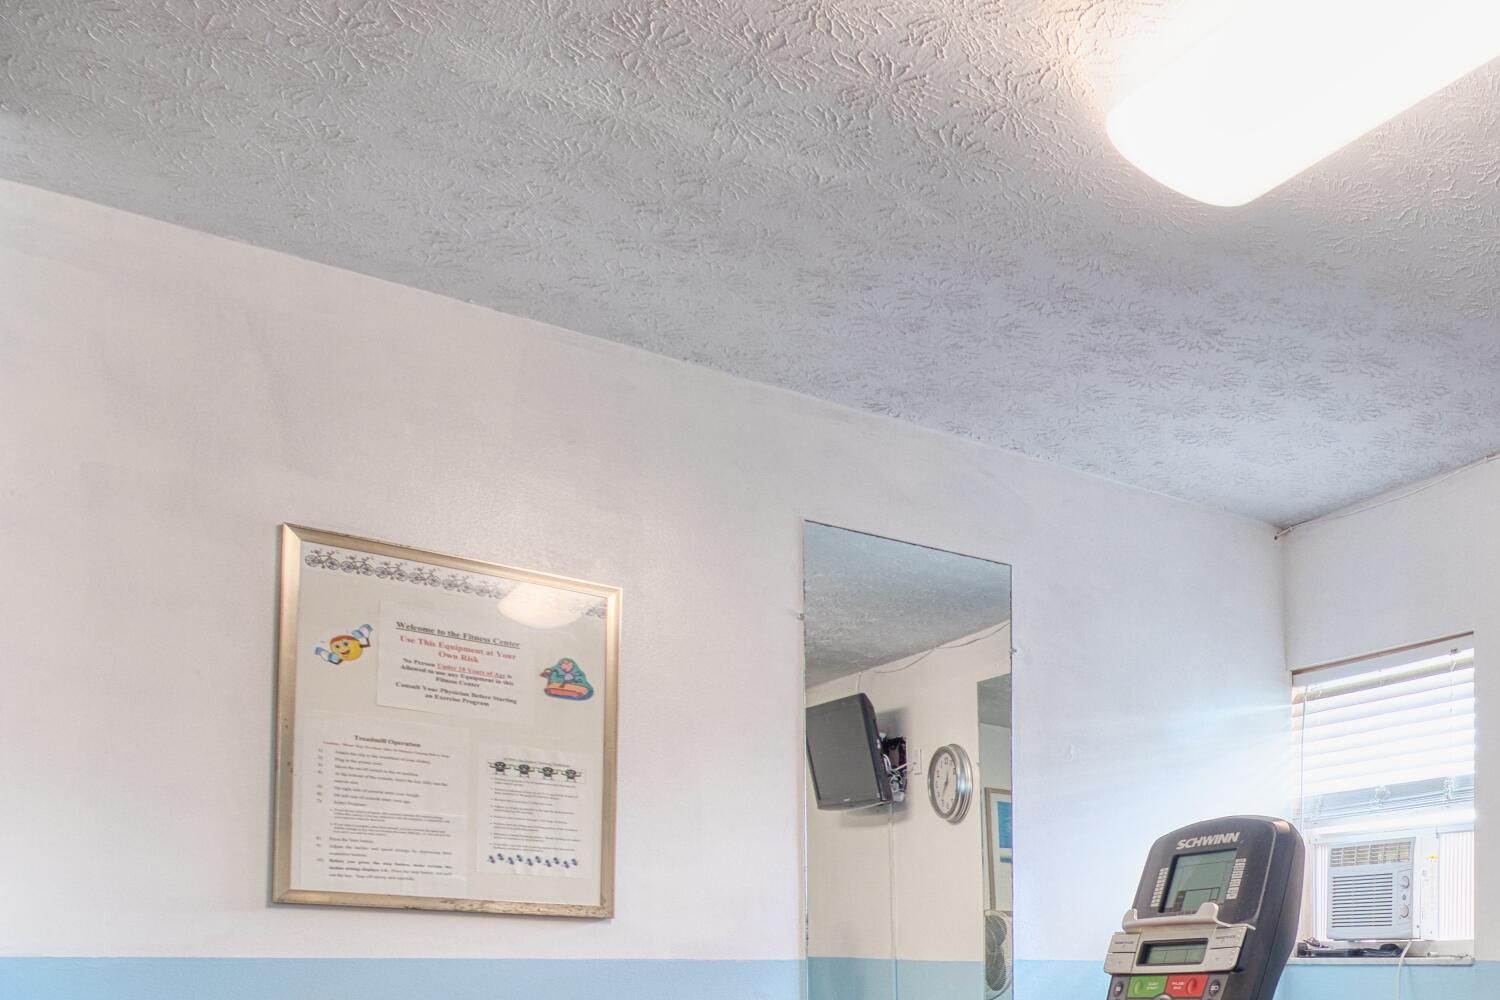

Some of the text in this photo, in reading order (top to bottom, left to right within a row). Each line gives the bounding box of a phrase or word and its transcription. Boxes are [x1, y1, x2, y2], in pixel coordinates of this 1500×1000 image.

[396, 621, 520, 648] Welcome to the Fitness Center
[400, 635, 415, 643] Use
[418, 638, 436, 647] This
[438, 641, 484, 655] Equipment
[496, 650, 517, 660] Your
[438, 651, 480, 664] Own Risk
[354, 735, 421, 748] Treadmill Operation
[1176, 832, 1240, 850] SCHWINN
